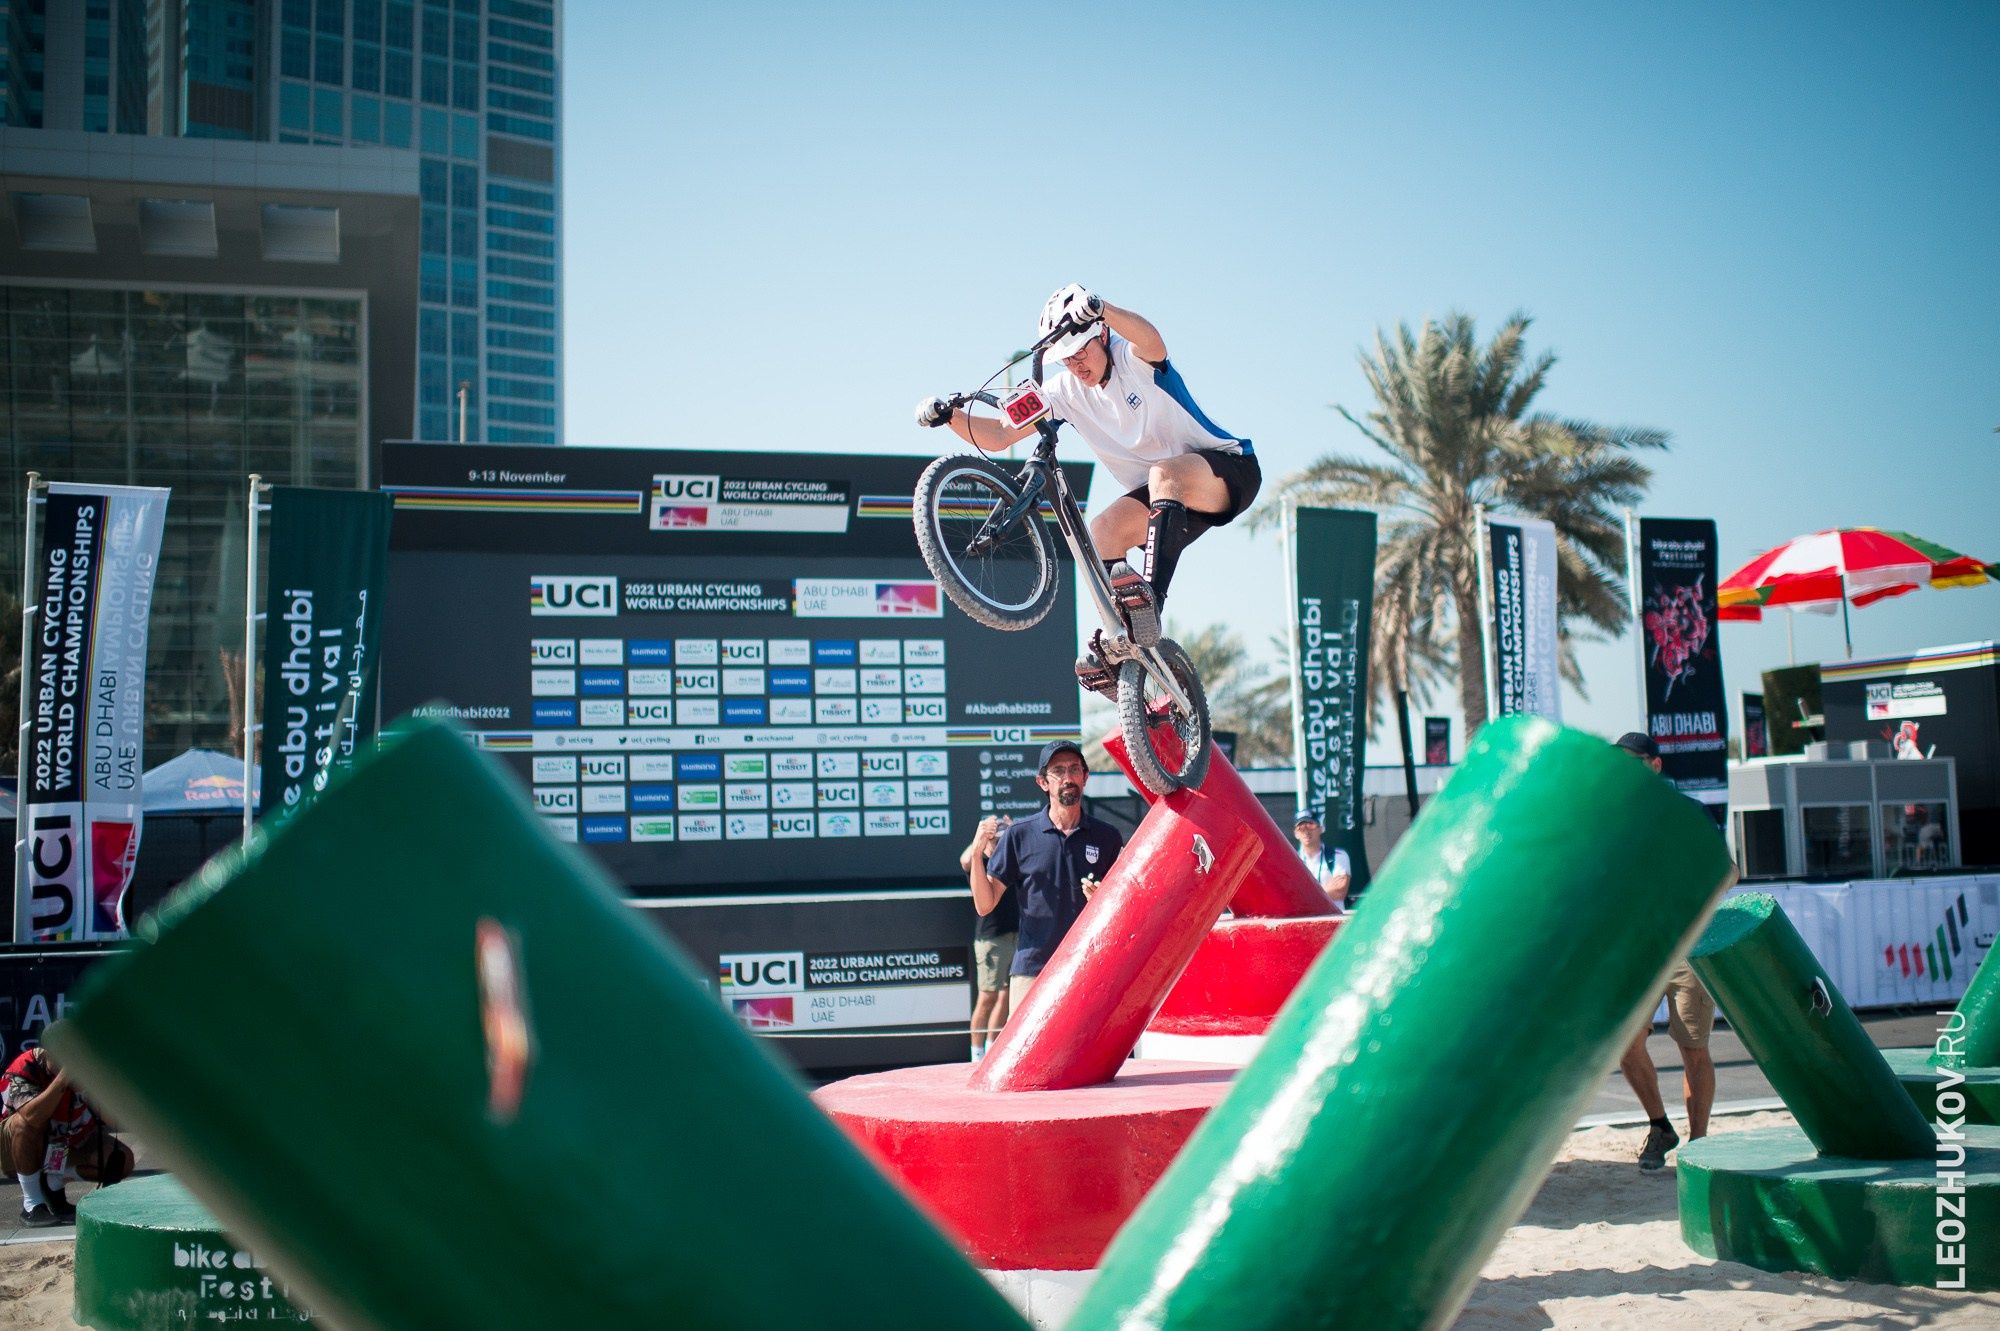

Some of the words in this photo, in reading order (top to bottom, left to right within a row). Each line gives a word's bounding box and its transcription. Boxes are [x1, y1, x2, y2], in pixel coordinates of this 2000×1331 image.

[1009, 395, 1040, 422] 308
[468, 470, 496, 482] 9-13
[499, 471, 567, 483] November
[664, 480, 713, 498] UCI
[723, 480, 746, 489] 2022
[748, 481, 783, 491] URBAN
[784, 482, 827, 491] CYCLING
[723, 491, 759, 500] WORLD
[762, 492, 845, 502] CHAMPIONSHIPS
[720, 508, 741, 516] ABU
[743, 508, 773, 517] DHABI
[720, 518, 739, 526] UAE
[1143, 526, 1156, 583] hebo
[546, 583, 611, 608] UCI
[625, 584, 654, 596] 2022
[657, 584, 702, 596] URBAN
[705, 584, 761, 597] CYCLING
[803, 586, 828, 597] ABU
[831, 586, 868, 597] DHABI
[43, 548, 67, 647] CYCLING
[61, 505, 95, 697] CHAMPIONSHIPS
[625, 598, 674, 610] WORLD
[677, 598, 787, 611] CHAMPIONSHIPS
[803, 600, 827, 611] UAE
[1498, 568, 1513, 651] CYCLING
[1507, 534, 1523, 693] CHAMPIONSHIPS
[281, 589, 313, 696] dhabi
[347, 589, 367, 688] مهرجان
[1302, 598, 1323, 691] dhabi
[539, 646, 571, 658] UCI
[729, 646, 760, 658] UCI
[683, 676, 714, 688] UCI
[1502, 654, 1515, 718] URBAN
[37, 653, 58, 733] URBAN
[1870, 687, 1891, 700] UCI
[96, 670, 117, 737] DHABI
[912, 704, 943, 716] UCI
[965, 703, 1051, 714] #Abudhabi2022
[306, 628, 342, 807] estival
[411, 705, 511, 719] #Abudhabi2022
[636, 706, 668, 718] UCI
[1323, 632, 1342, 798] Festival
[1307, 699, 1326, 762] abu
[1652, 714, 1673, 736] ABU
[1674, 712, 1717, 736] DHABI
[278, 706, 308, 778] abu
[994, 729, 1025, 742] UCI
[55, 702, 76, 791] WORLD
[994, 753, 1024, 762] uci.org
[36, 738, 52, 792] 2022
[95, 745, 112, 790] ABU
[117, 747, 137, 790] UAE
[589, 762, 621, 774] UCI
[871, 758, 900, 771] UCI
[184, 788, 225, 801] Red
[825, 789, 855, 801] UCI
[995, 786, 1011, 794] UCI
[540, 794, 573, 806] UCI
[731, 794, 762, 802] TISSOT
[996, 801, 1041, 810] ucichannel
[684, 825, 716, 833] TISSOT
[779, 820, 810, 832] UCI
[870, 821, 900, 829] TISSOT
[916, 816, 946, 829] UCI
[32, 815, 73, 931] UCI
[809, 958, 838, 970] 2022
[840, 955, 884, 969] URBAN
[888, 953, 940, 967] CYCLING
[734, 960, 797, 987] UCI
[809, 969, 857, 984] WORLD
[859, 966, 964, 983] CHAMPIONSHIPS
[810, 996, 836, 1009] ABU
[838, 995, 876, 1008] DHABI
[811, 1011, 835, 1023] UAE
[174, 1242, 228, 1269] bike
[201, 1274, 290, 1301] Festi
